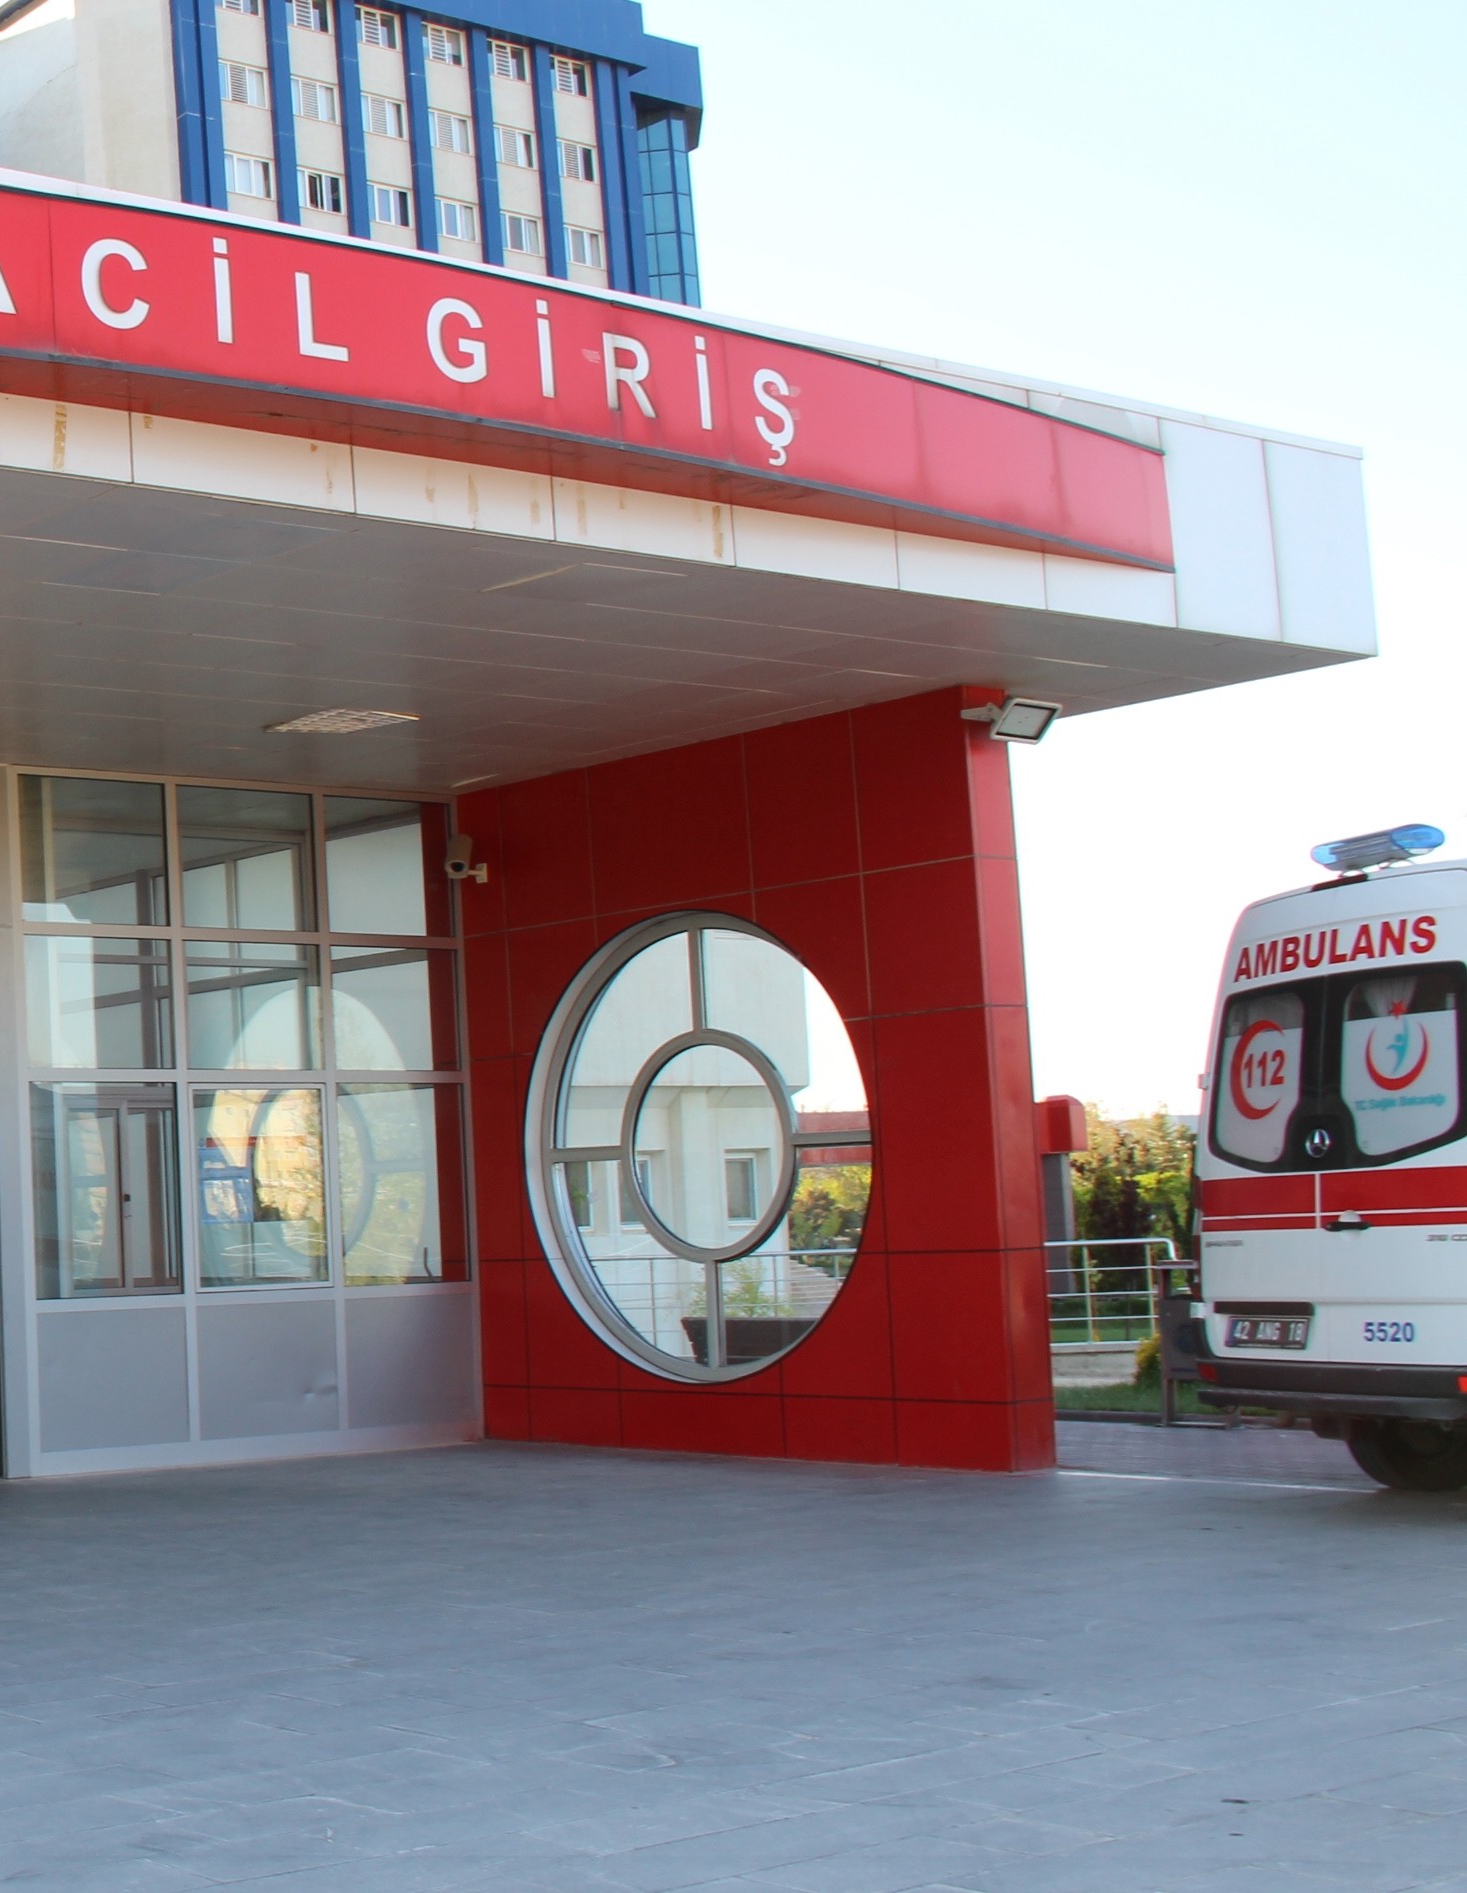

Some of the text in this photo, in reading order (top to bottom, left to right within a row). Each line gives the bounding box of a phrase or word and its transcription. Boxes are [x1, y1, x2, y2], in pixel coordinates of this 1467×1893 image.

[426, 297, 795, 466] GİRİŞ
[1234, 914, 1438, 983] AMBULANS
[1244, 1049, 1286, 1089] 112
[1233, 1320, 1250, 1340] 42
[1364, 1321, 1415, 1343] 5520
